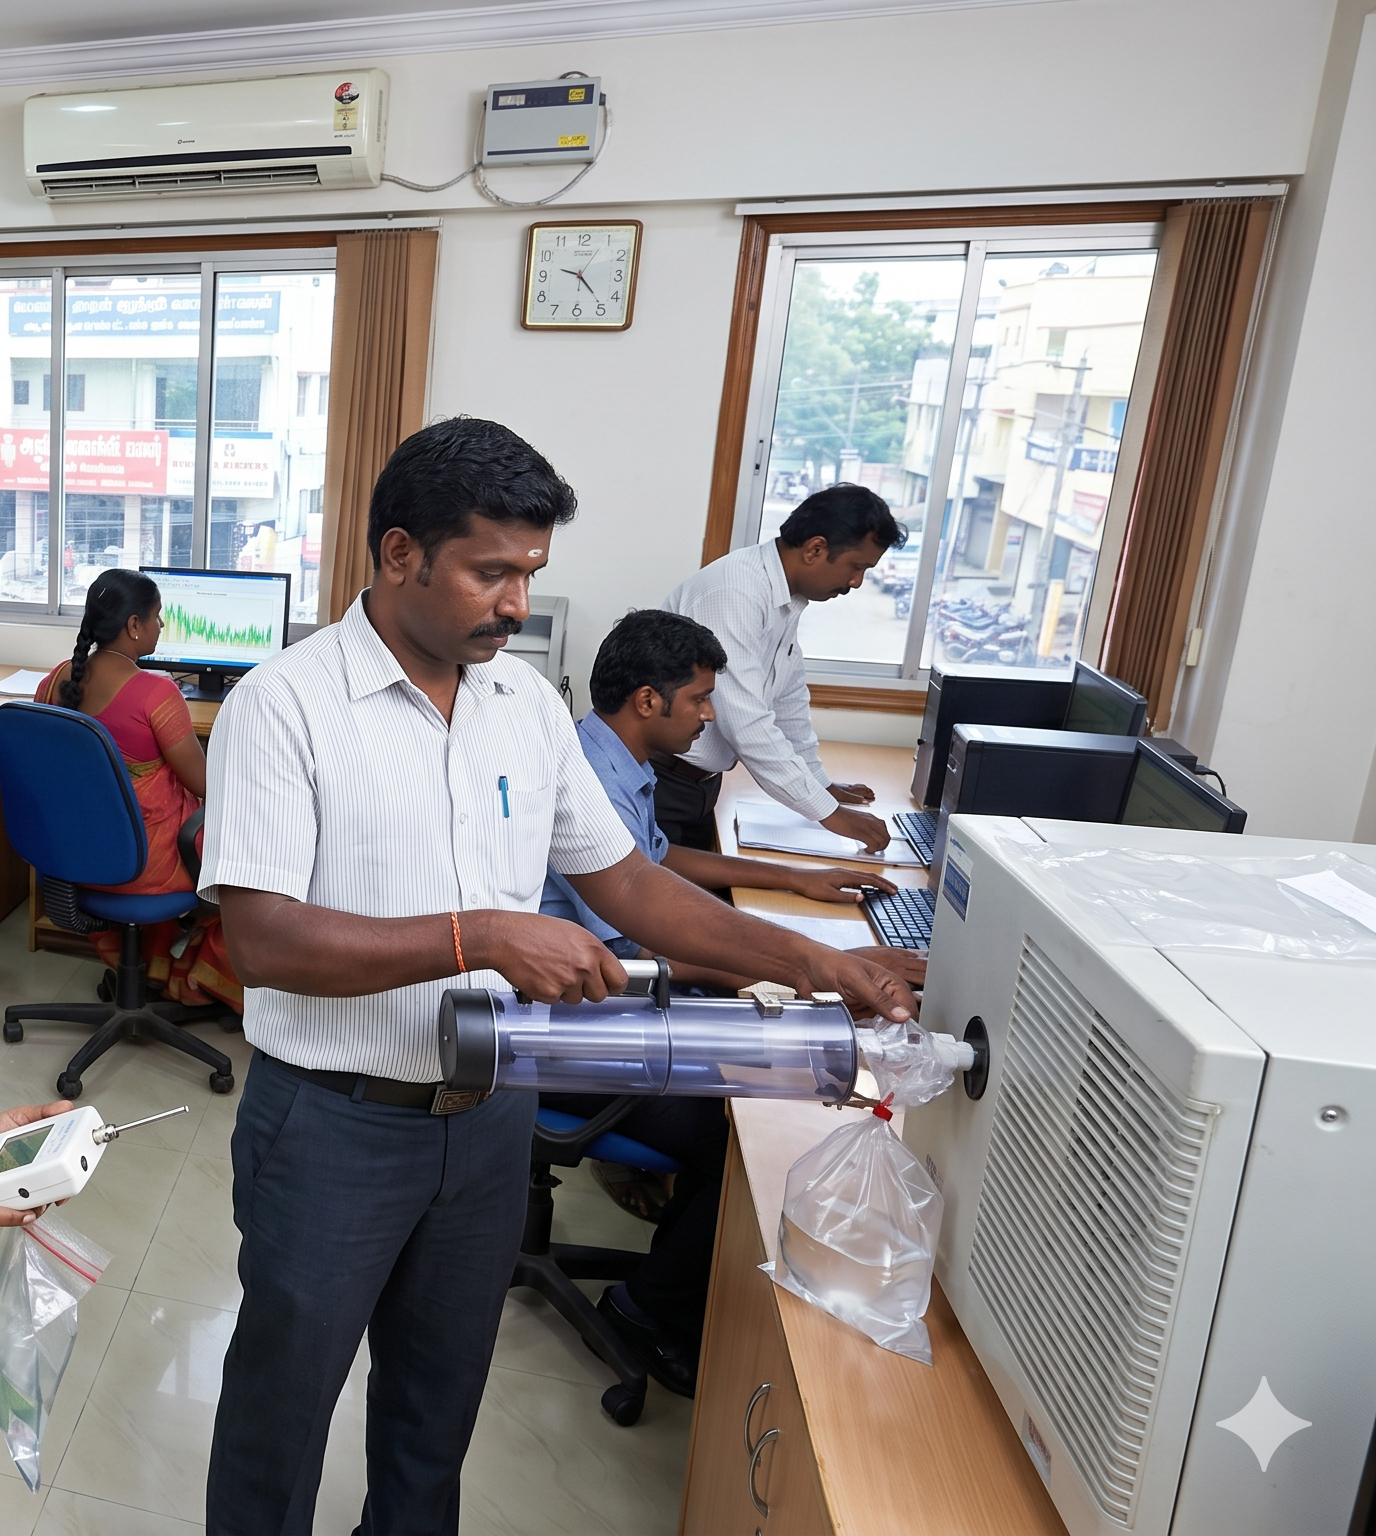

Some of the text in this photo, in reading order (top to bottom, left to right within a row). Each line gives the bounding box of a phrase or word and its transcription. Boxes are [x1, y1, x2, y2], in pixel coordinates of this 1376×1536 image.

[555, 235, 566, 247] 11
[577, 233, 592, 247] 12
[607, 234, 611, 247] 1
[541, 250, 552, 263] 10
[616, 249, 626, 262] 2
[538, 270, 548, 283] 9
[613, 270, 623, 283] 3
[537, 290, 546, 303] 8
[611, 291, 620, 303] 4
[550, 304, 559, 316] 7
[571, 303, 582, 317] 6
[595, 303, 606, 317] 5
